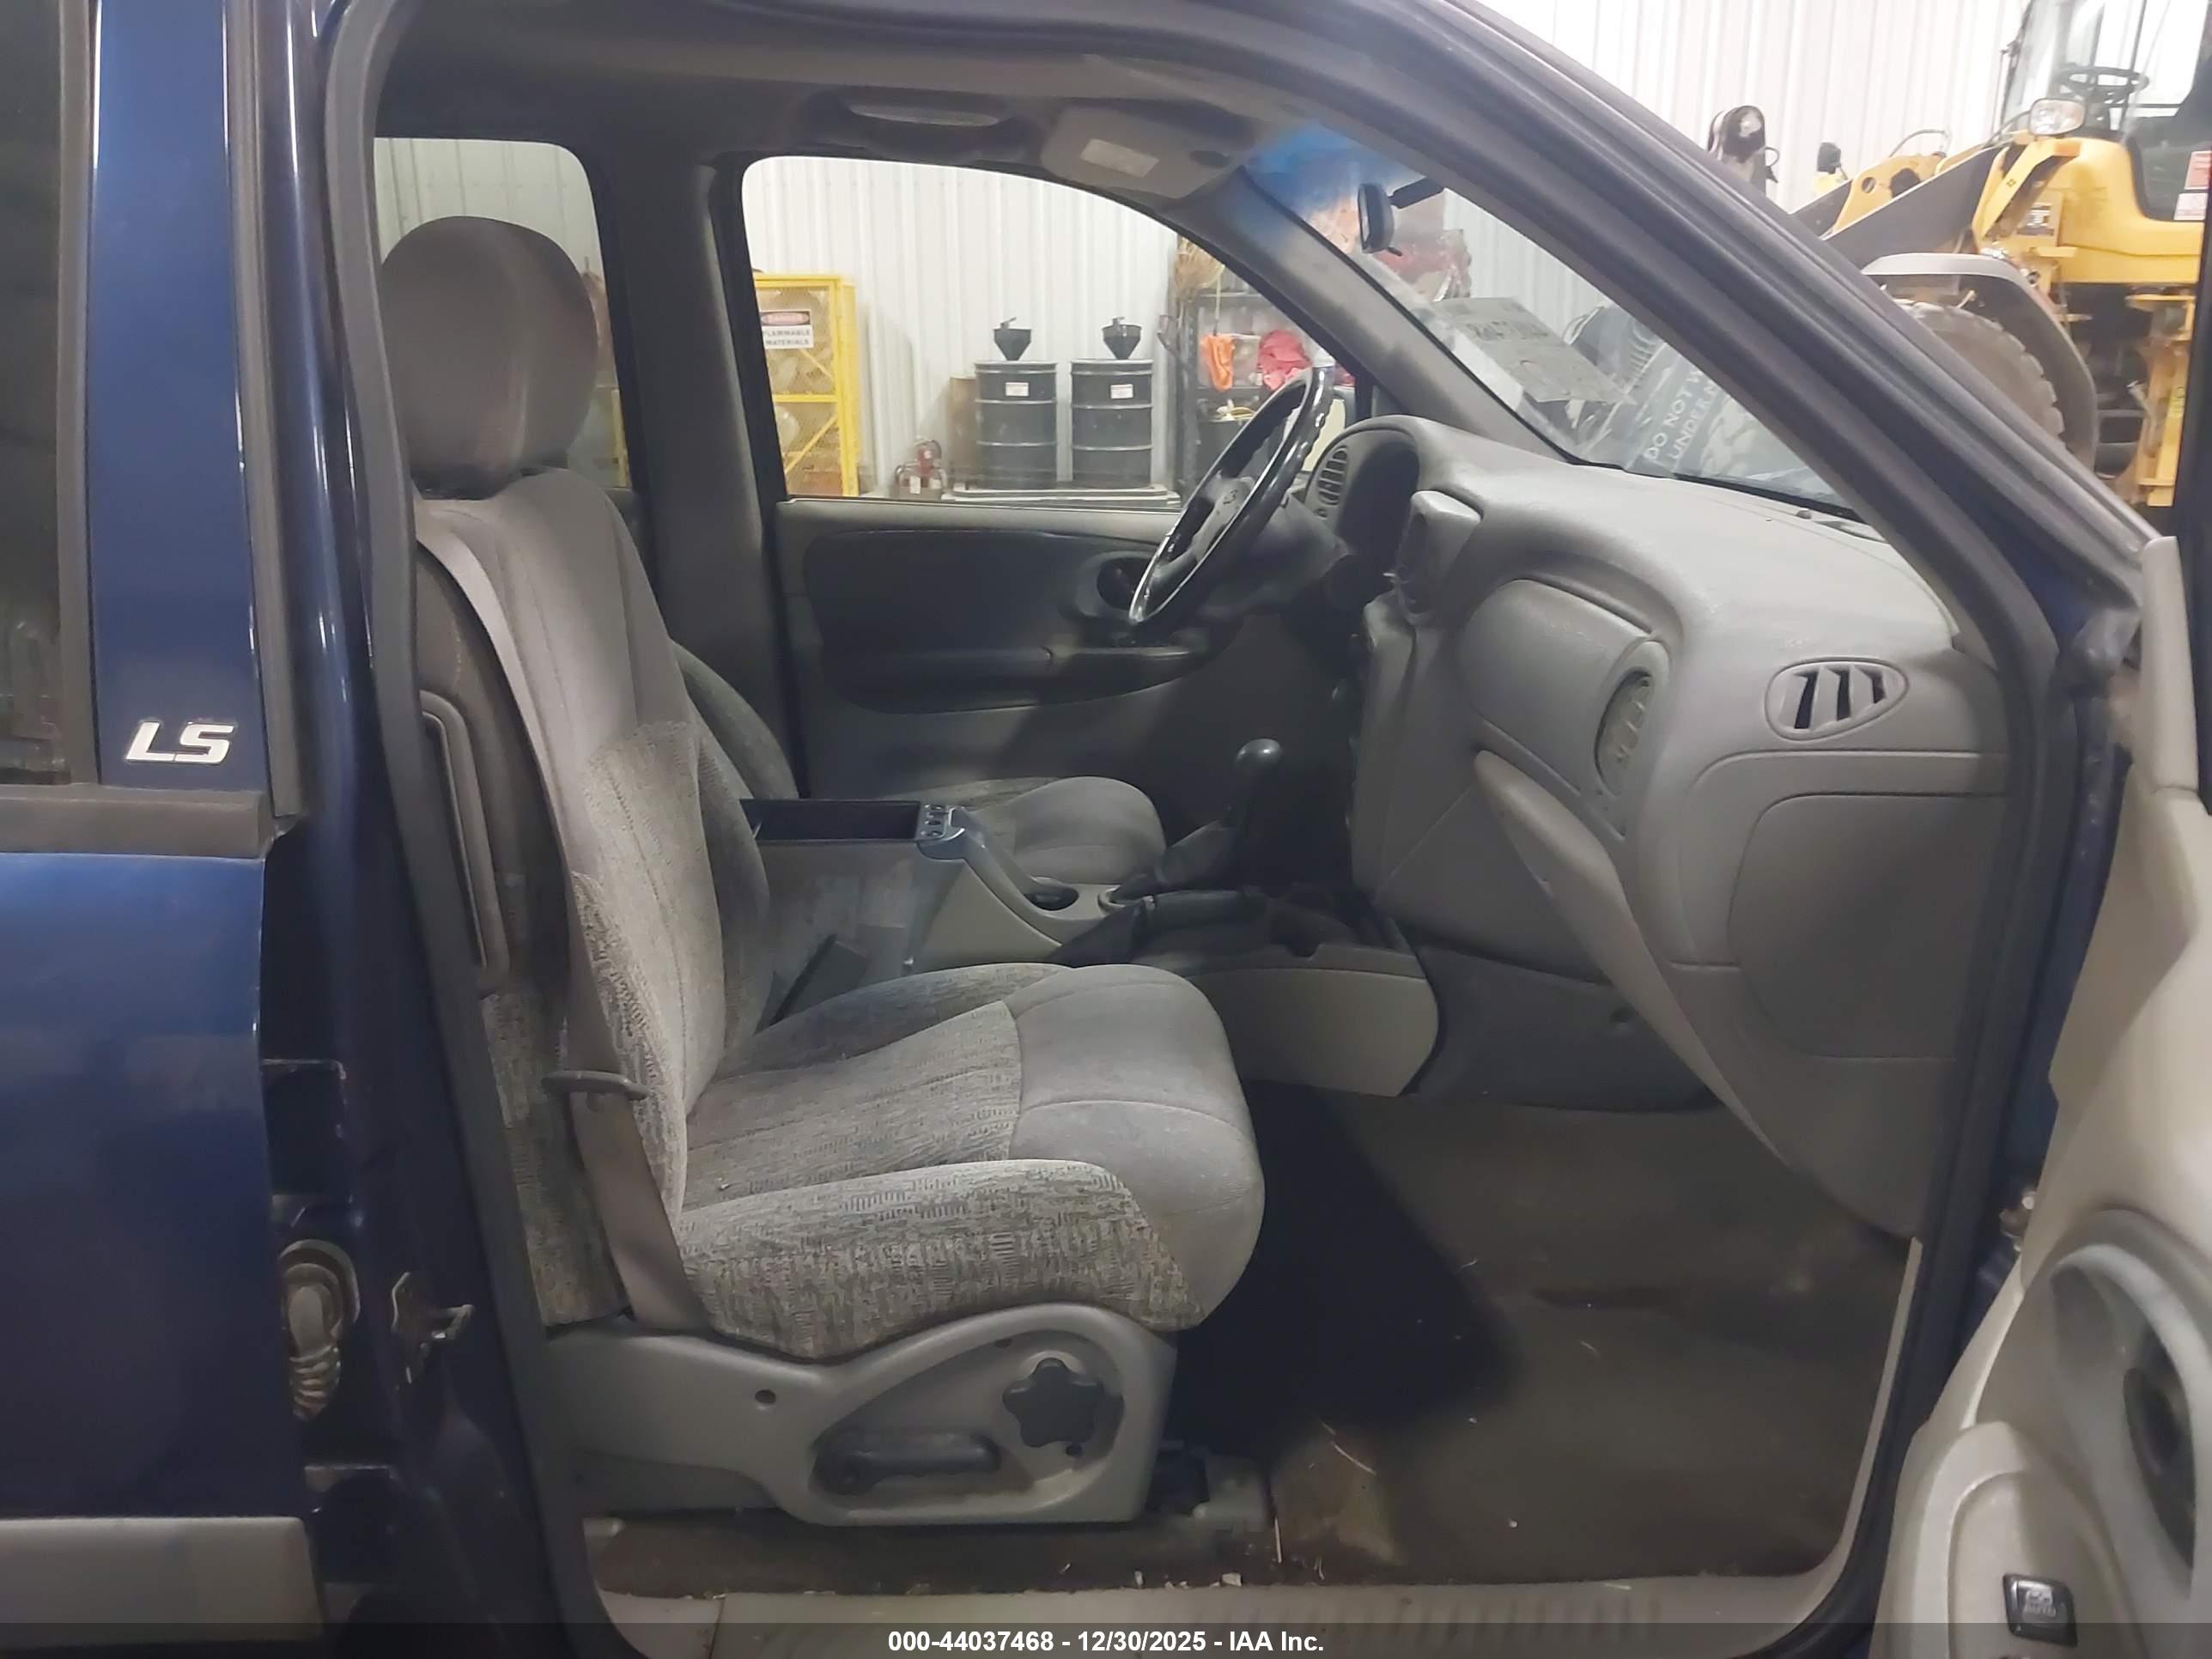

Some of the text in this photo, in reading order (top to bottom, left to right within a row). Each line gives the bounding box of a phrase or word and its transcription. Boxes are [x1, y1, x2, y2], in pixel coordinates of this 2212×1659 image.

[1642, 386, 1693, 459] DO NOT
[125, 720, 234, 763] LS
